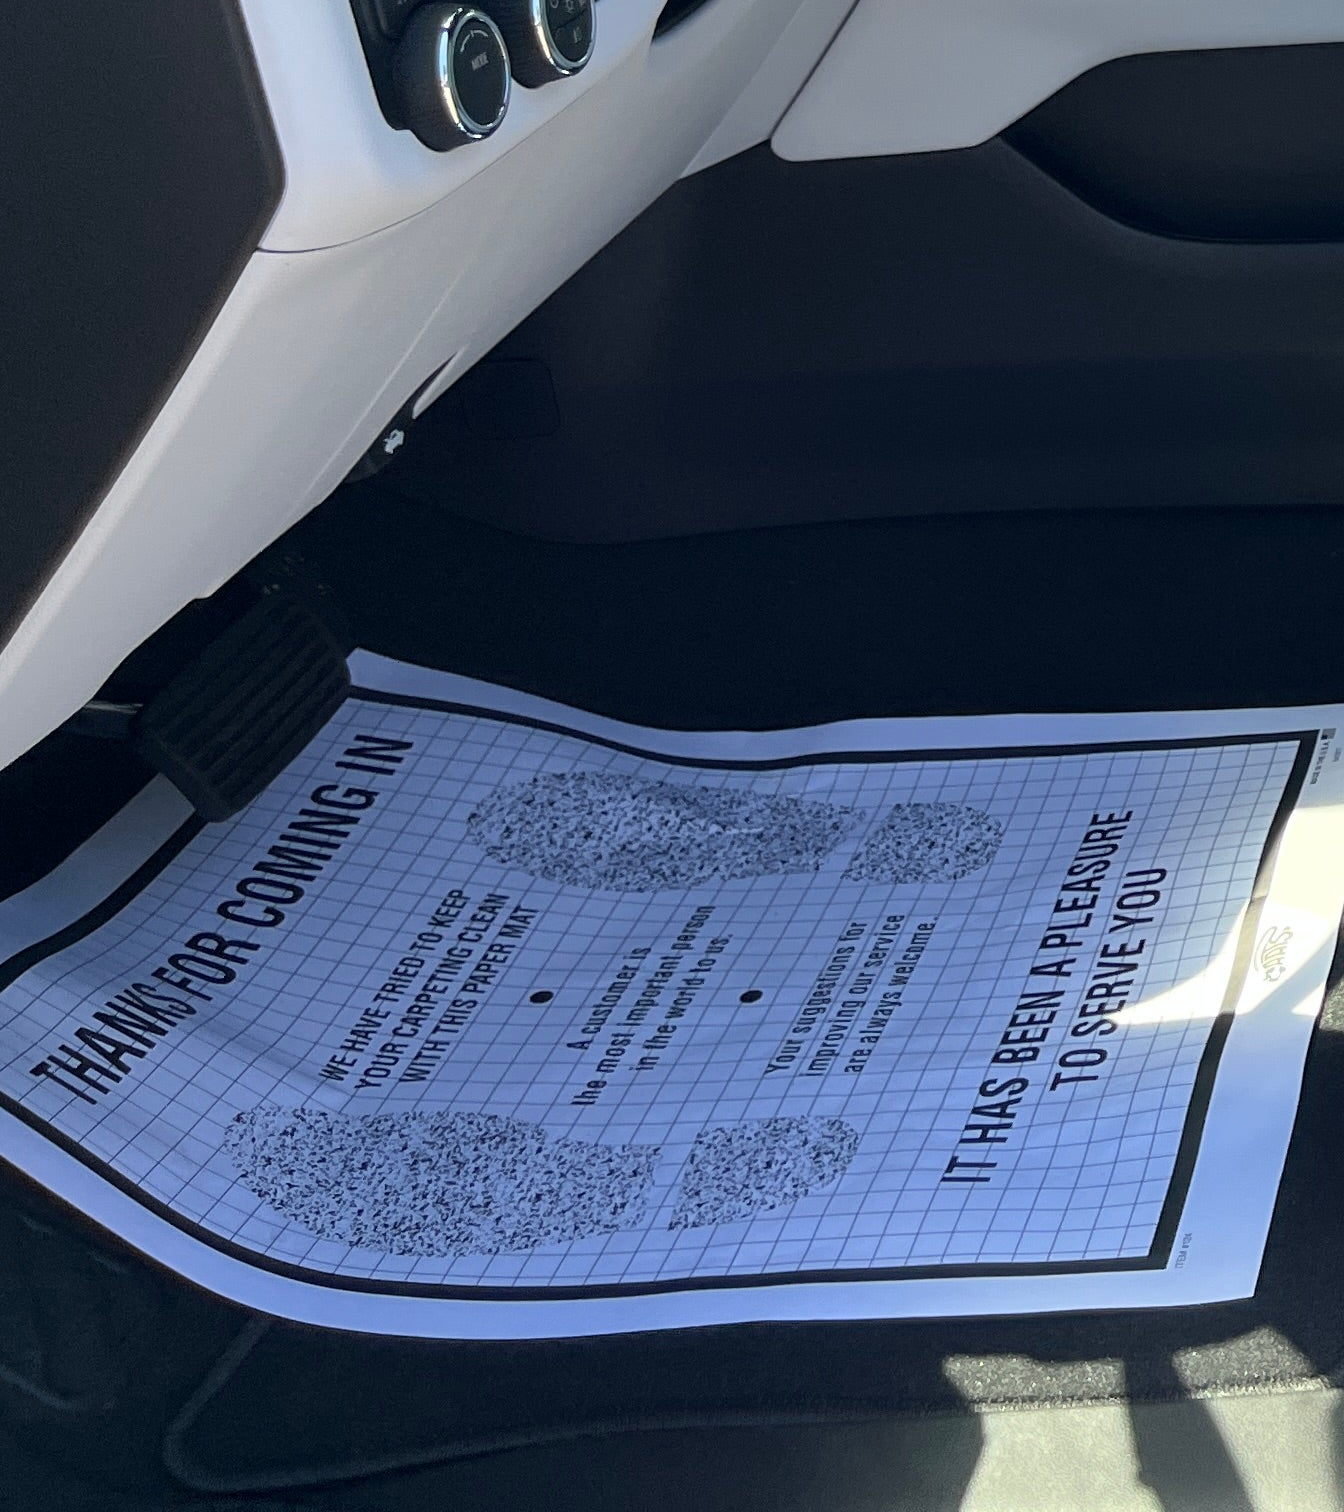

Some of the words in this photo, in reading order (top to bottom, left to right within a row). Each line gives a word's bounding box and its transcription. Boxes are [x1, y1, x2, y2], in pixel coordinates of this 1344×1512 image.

[1039, 809, 1134, 951] PLEASURE
[1109, 867, 1167, 935] YOU
[29, 982, 197, 1105] THANKS
[152, 932, 261, 1002] FOR
[216, 784, 379, 928] COMING
[335, 734, 414, 776] IN
[705, 934, 733, 954] us.
[849, 972, 876, 995] our
[864, 915, 905, 969] service
[318, 1054, 358, 1081] WE
[340, 1007, 391, 1052] HAVE
[373, 956, 425, 1003] TRIED
[410, 932, 443, 951] TO
[428, 889, 471, 928] KEEP
[355, 1043, 409, 1088] YOUR
[392, 947, 473, 1038] CARPETING
[458, 893, 510, 943] CLEAN
[399, 1040, 450, 1083] WITH
[432, 999, 478, 1033] THIS
[461, 943, 516, 994] PAPER
[499, 905, 539, 938] MAT
[566, 1039, 593, 1050] A
[581, 960, 640, 1034] customer
[623, 947, 651, 960] is
[664, 978, 705, 1020] world
[689, 958, 716, 973] to
[764, 1039, 804, 1075] Your
[792, 947, 855, 1034] suggestions
[839, 922, 867, 942] for
[844, 1049, 872, 1073] are
[859, 992, 902, 1044] always
[888, 916, 940, 986] welcome.
[1030, 957, 1076, 977] A
[1071, 938, 1146, 1037] SERVE
[570, 1079, 607, 1106] the
[595, 1033, 635, 1074] most
[616, 955, 684, 1026] important
[671, 906, 716, 951] person
[642, 1025, 677, 1050] the
[991, 990, 1066, 1064] BEEN
[628, 1056, 660, 1071] in
[1050, 1048, 1108, 1091] TO
[960, 1077, 1029, 1144] HAS
[940, 1156, 997, 1182] IT
